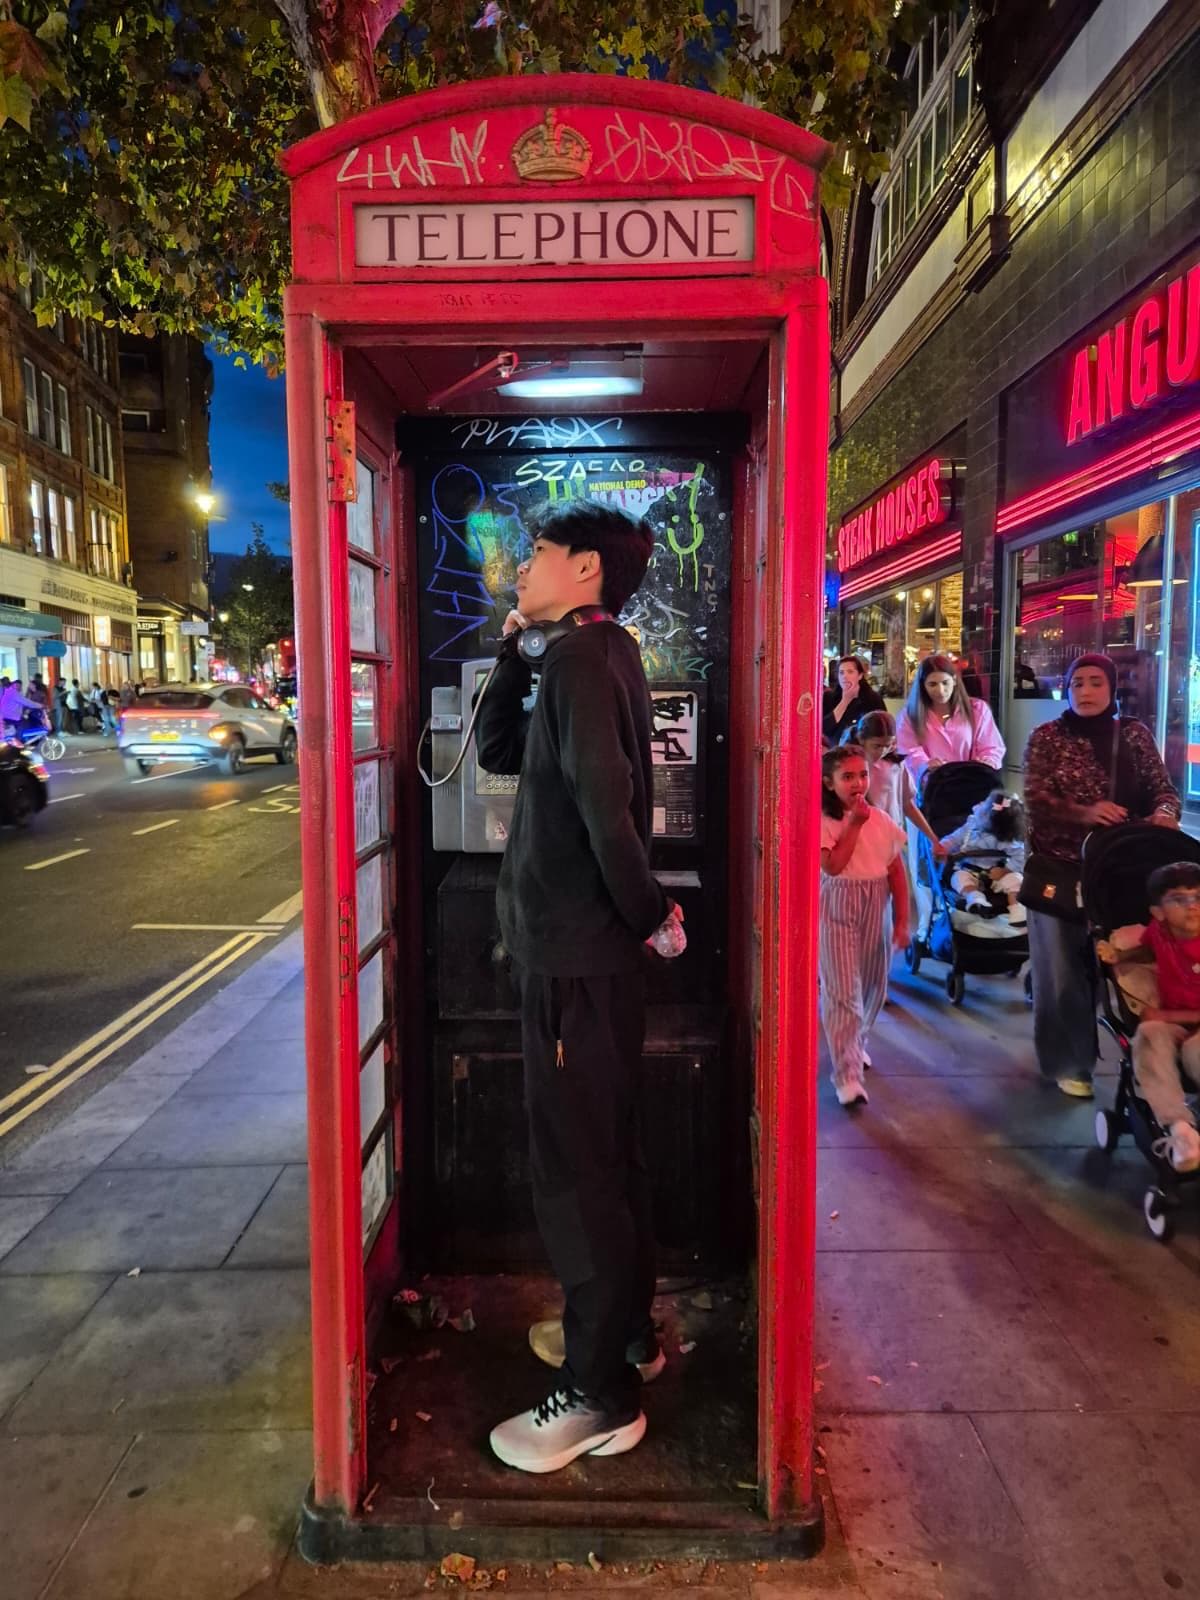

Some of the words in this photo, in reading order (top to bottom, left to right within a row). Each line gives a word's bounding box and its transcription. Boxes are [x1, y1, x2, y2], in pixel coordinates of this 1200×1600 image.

[371, 208, 738, 262] TELEPHONE
[1066, 262, 1200, 447] ANGU
[588, 480, 625, 492] NATIONAL
[625, 479, 647, 490] DEMO
[838, 505, 873, 573] STEAK
[875, 459, 940, 553] HOUSES
